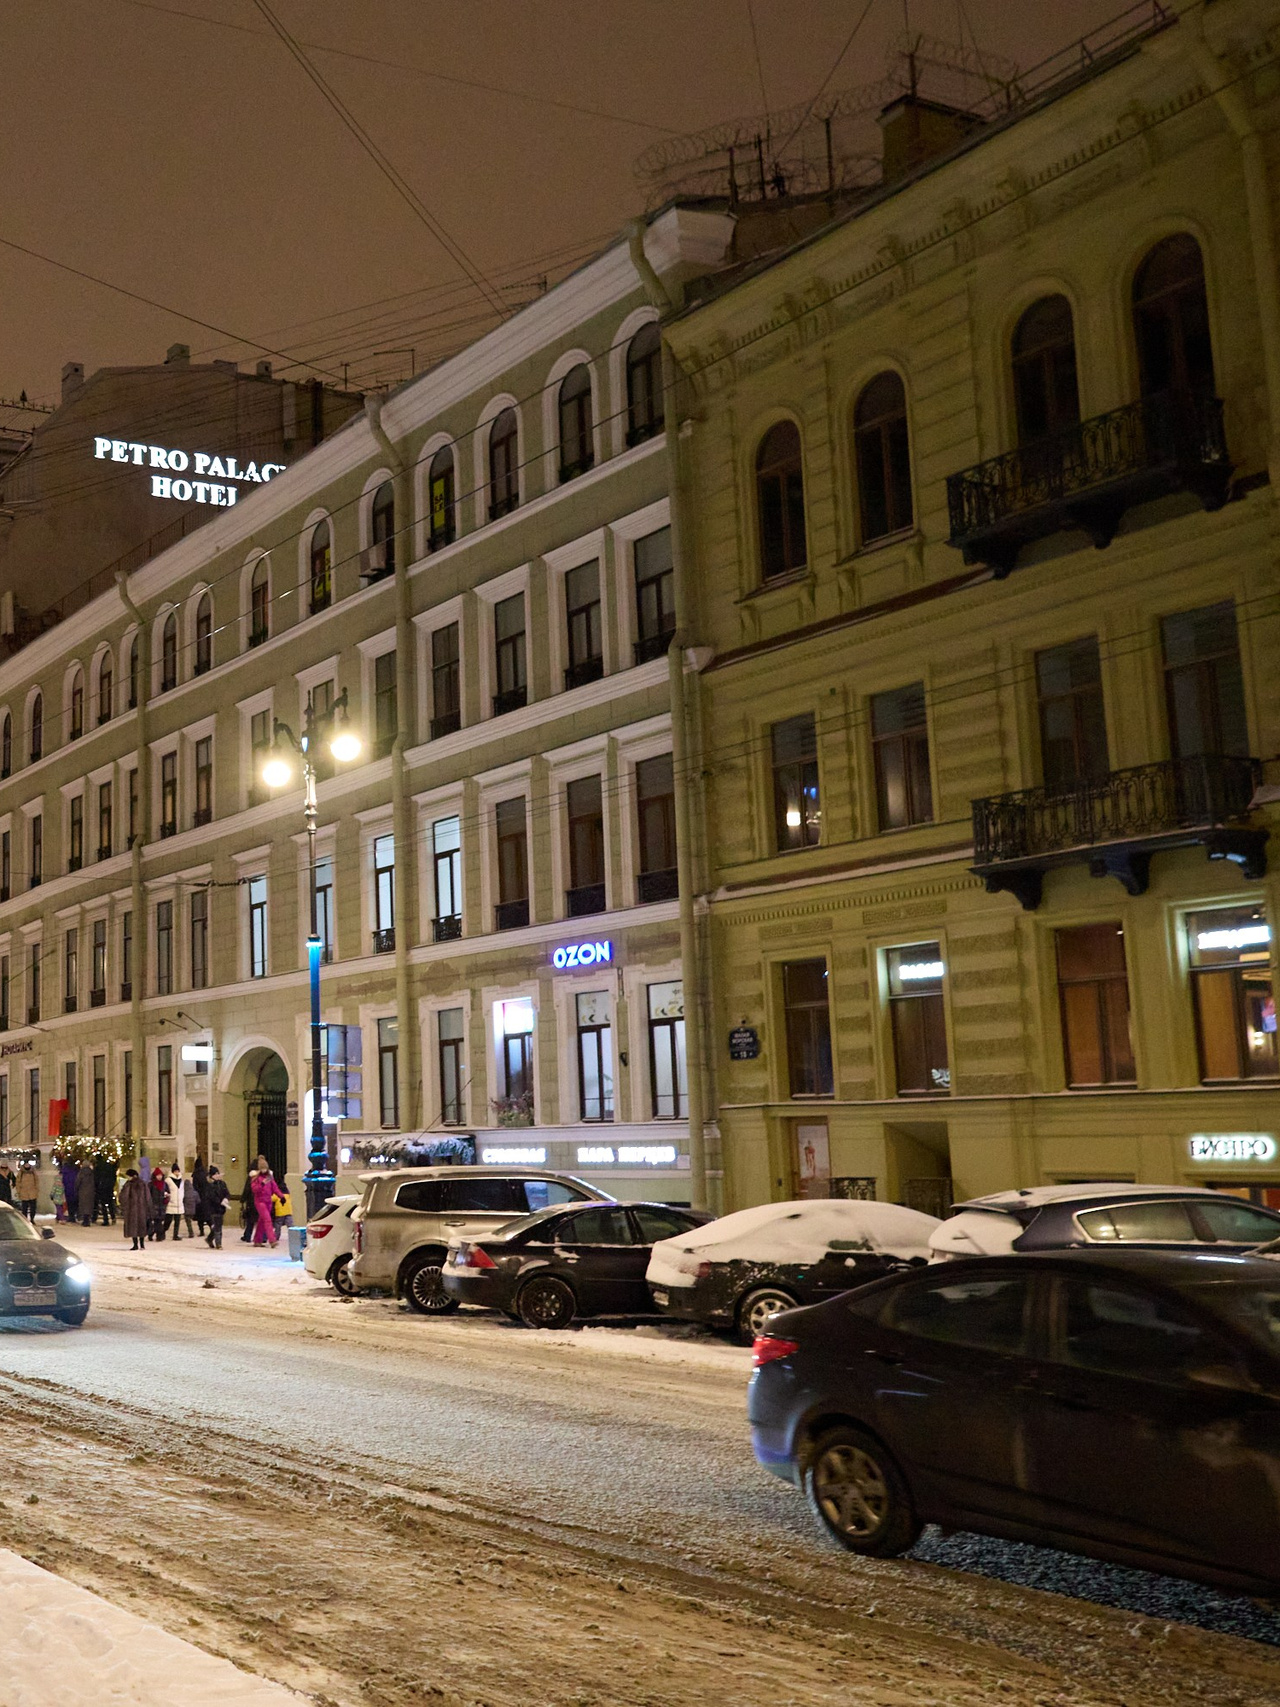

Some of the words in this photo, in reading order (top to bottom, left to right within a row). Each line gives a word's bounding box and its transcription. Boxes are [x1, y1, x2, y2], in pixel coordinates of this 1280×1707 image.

[94, 437, 189, 472] PETRO
[193, 452, 286, 483] PALAC
[553, 940, 610, 969] OZON
[1190, 1138, 1272, 1158] БИСТРО
